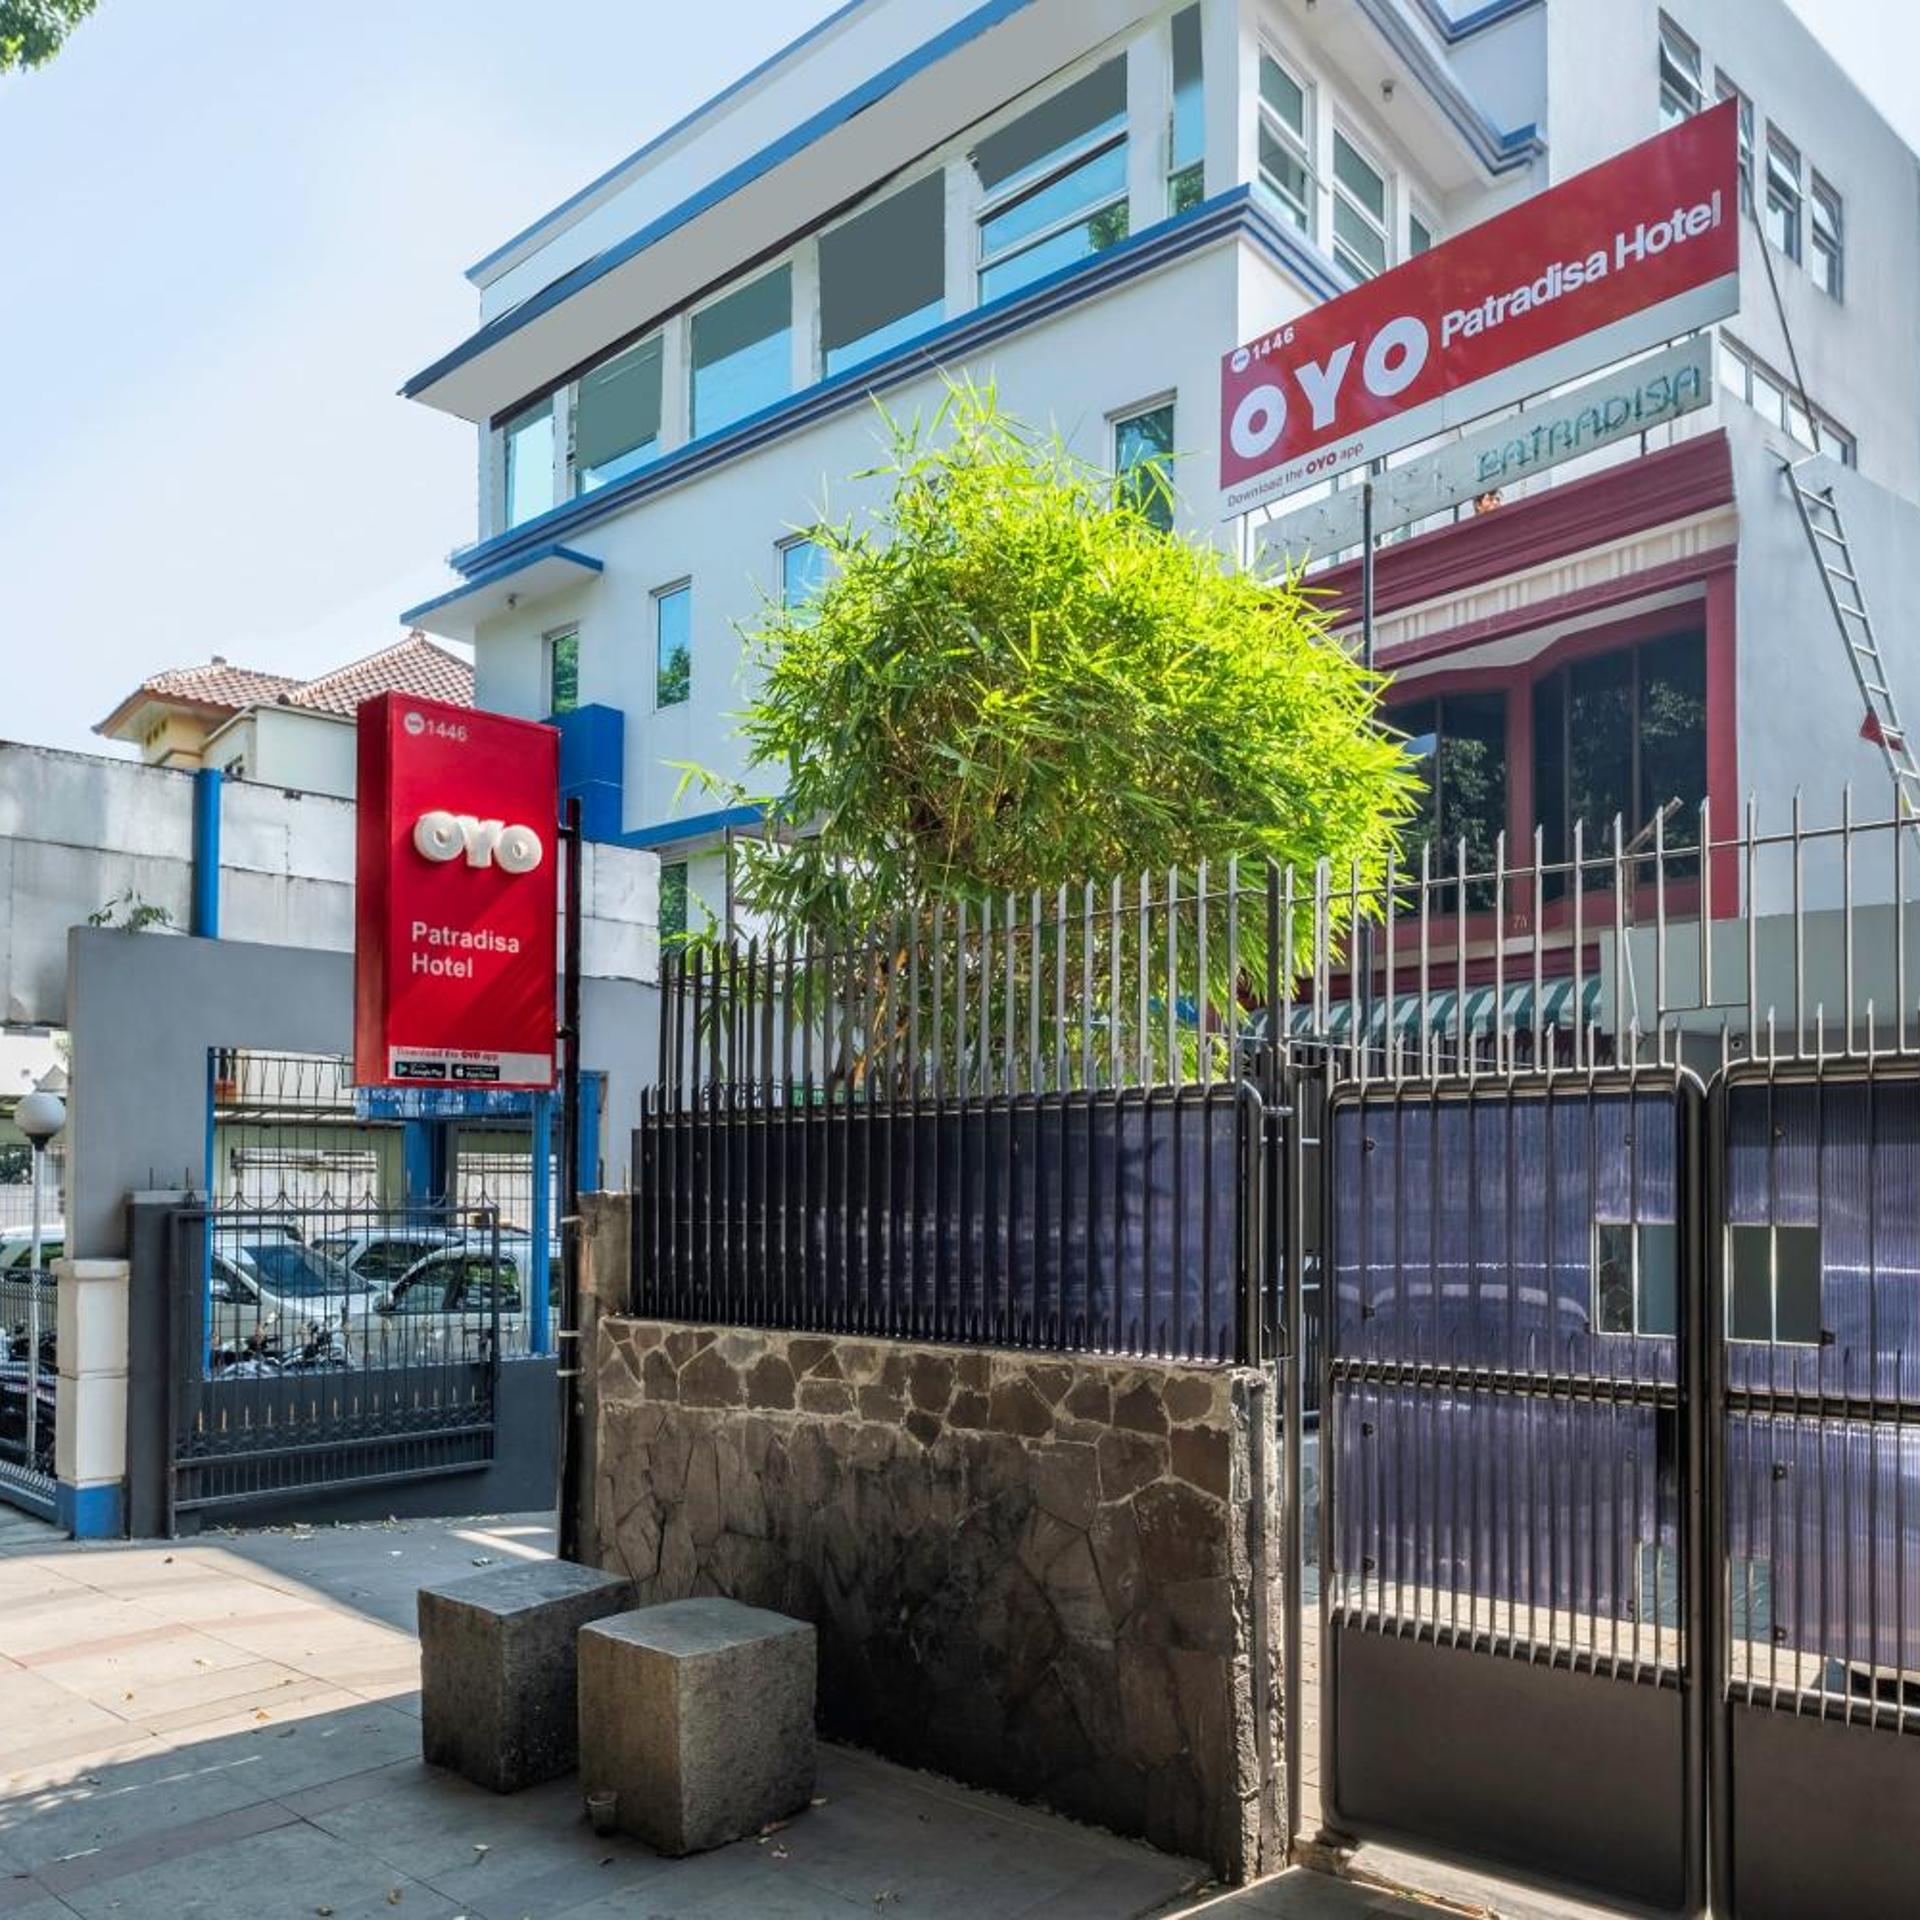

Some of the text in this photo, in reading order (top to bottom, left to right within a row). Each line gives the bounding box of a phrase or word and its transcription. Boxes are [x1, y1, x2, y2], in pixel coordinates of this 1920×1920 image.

[1441, 190, 1722, 348] Patradisa Hotel
[1252, 326, 1295, 360] 1446
[1230, 316, 1430, 459] OYO
[1227, 443, 1365, 508] Download the OYO app
[427, 719, 468, 742] 1446
[413, 810, 543, 874] OYO
[411, 921, 520, 954] Patradisa
[411, 953, 474, 979] Hotel
